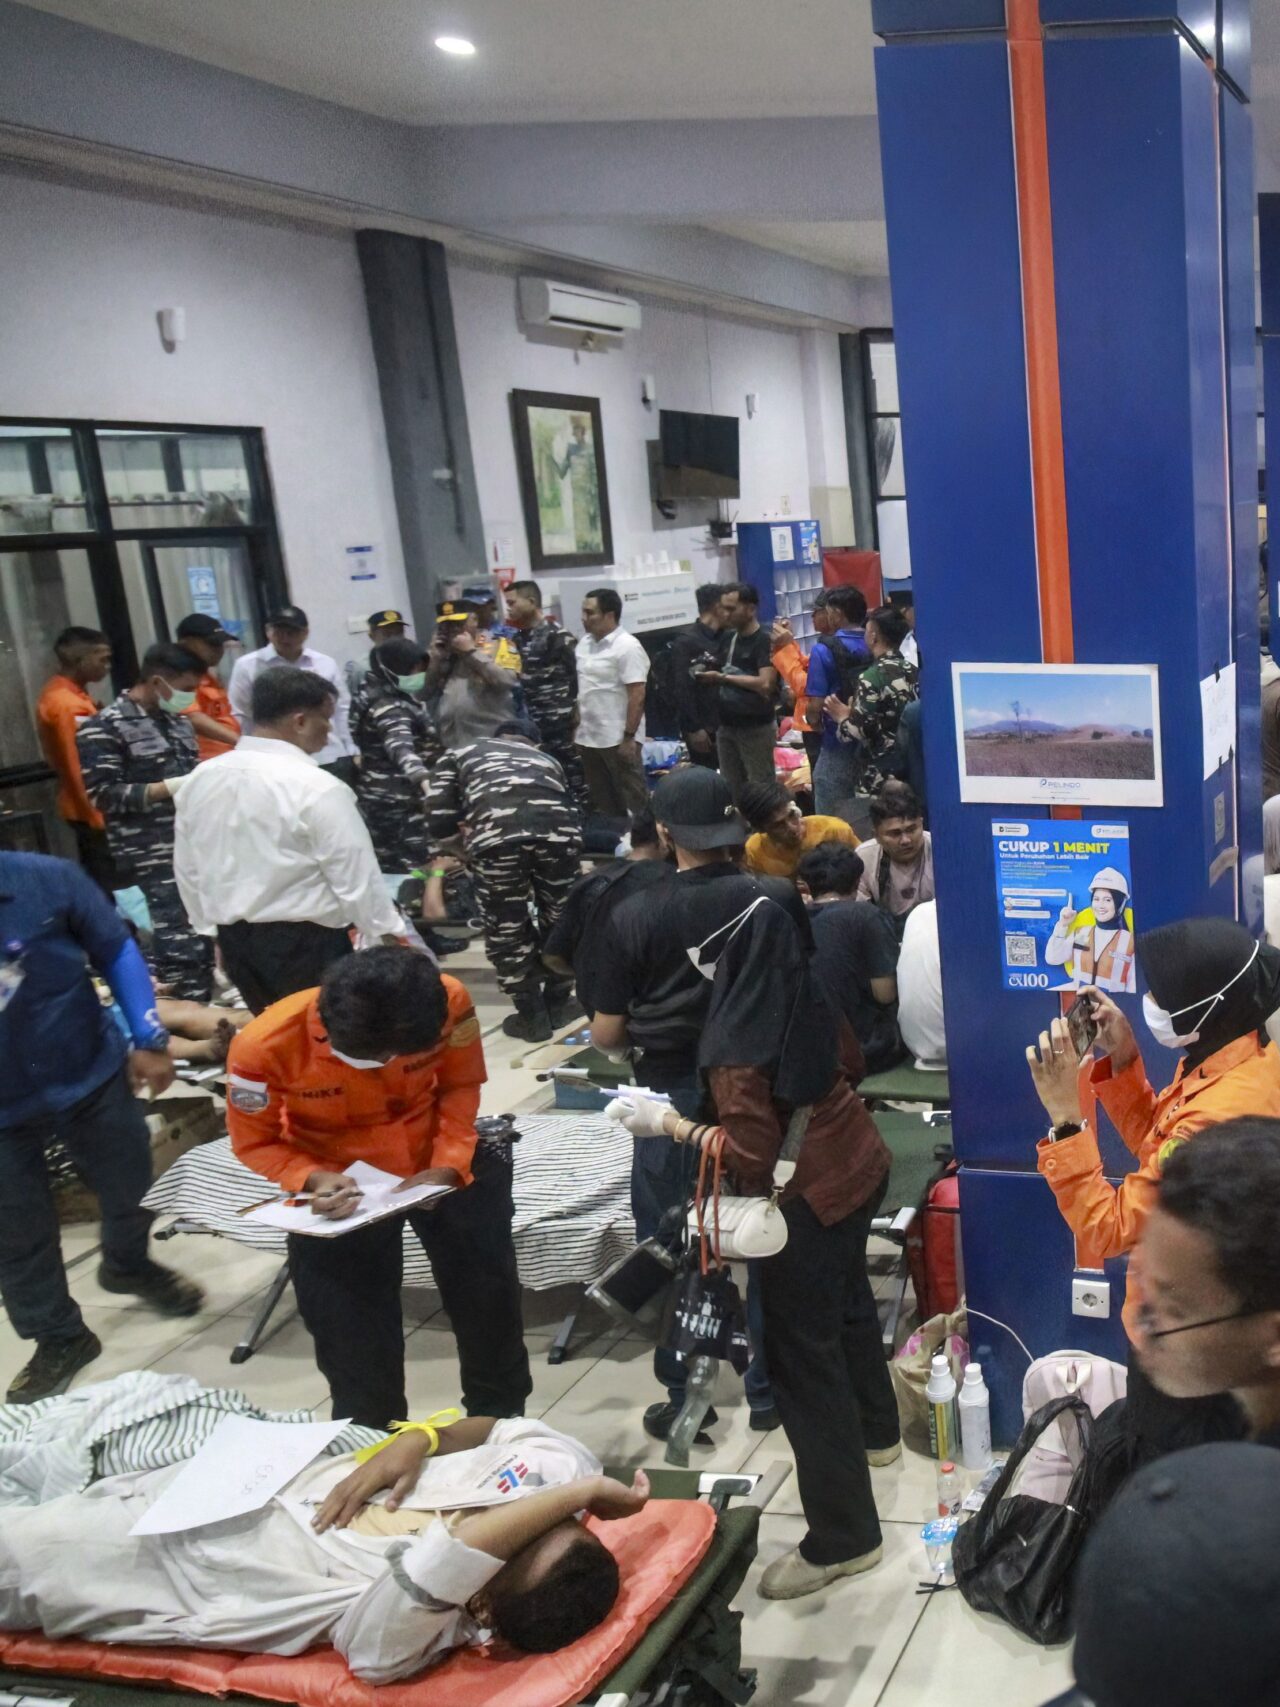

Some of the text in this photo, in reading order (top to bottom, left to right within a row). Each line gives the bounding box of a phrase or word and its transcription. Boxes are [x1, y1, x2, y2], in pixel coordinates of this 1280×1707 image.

[998, 840, 1110, 854] CUKUP 1 MENIT
